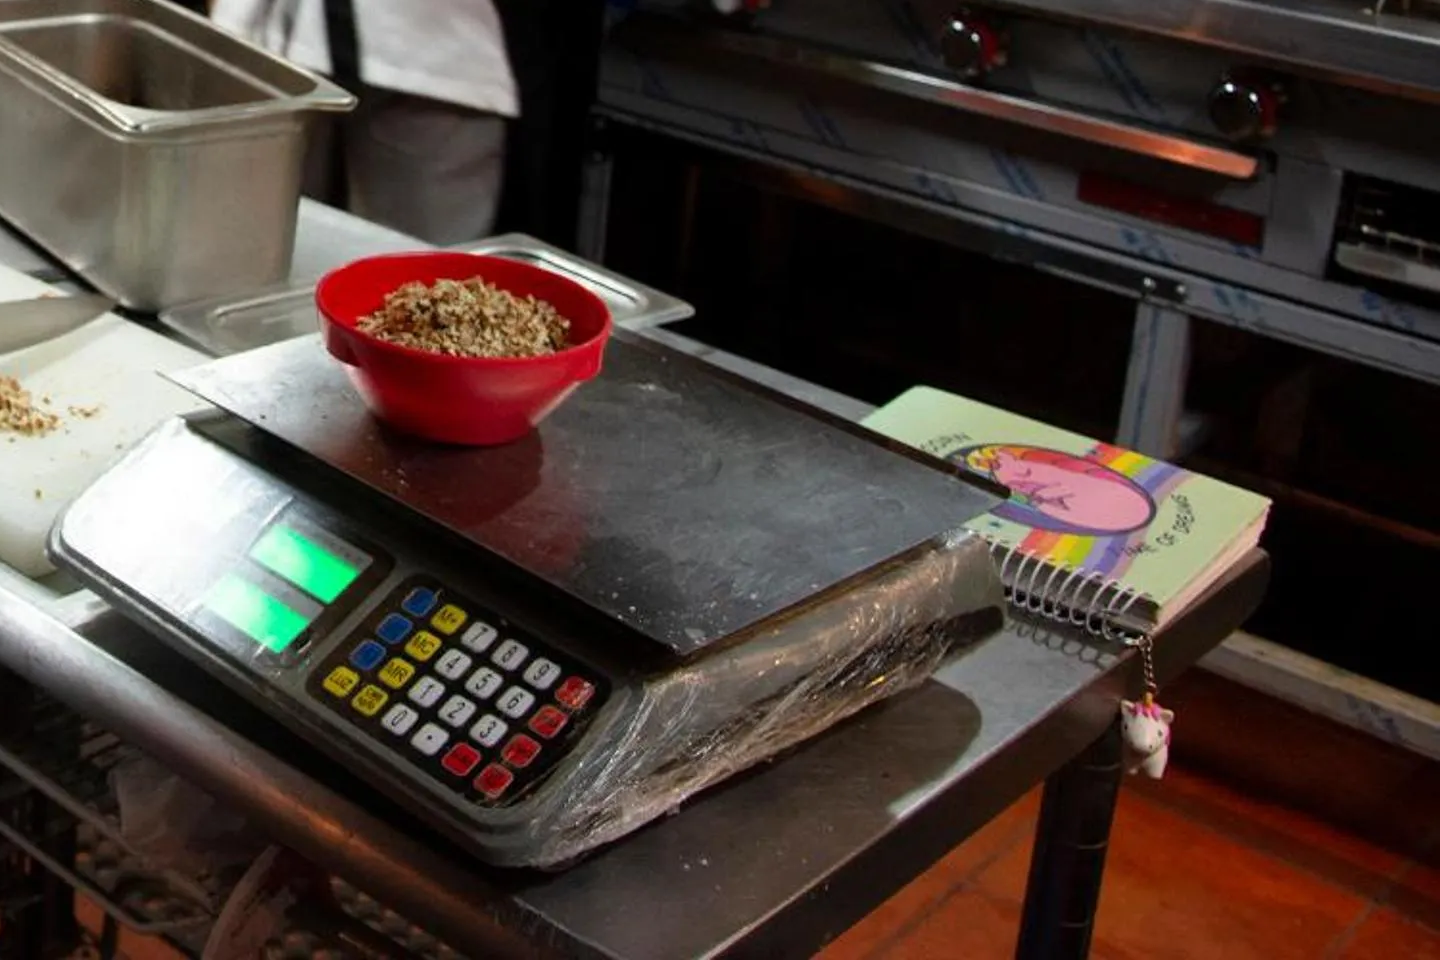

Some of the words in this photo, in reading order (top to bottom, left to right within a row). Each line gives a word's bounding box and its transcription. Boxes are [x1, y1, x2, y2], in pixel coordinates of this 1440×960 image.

[1156, 532, 1175, 546] OF
[473, 625, 489, 640] 7
[501, 645, 518, 663] 8
[445, 656, 461, 673] 4
[533, 663, 550, 681] 9
[476, 673, 493, 689] 5
[419, 683, 434, 700] 1
[506, 692, 524, 709] 6
[391, 710, 408, 727] 0
[448, 701, 466, 719] 2
[479, 721, 497, 739] 3
